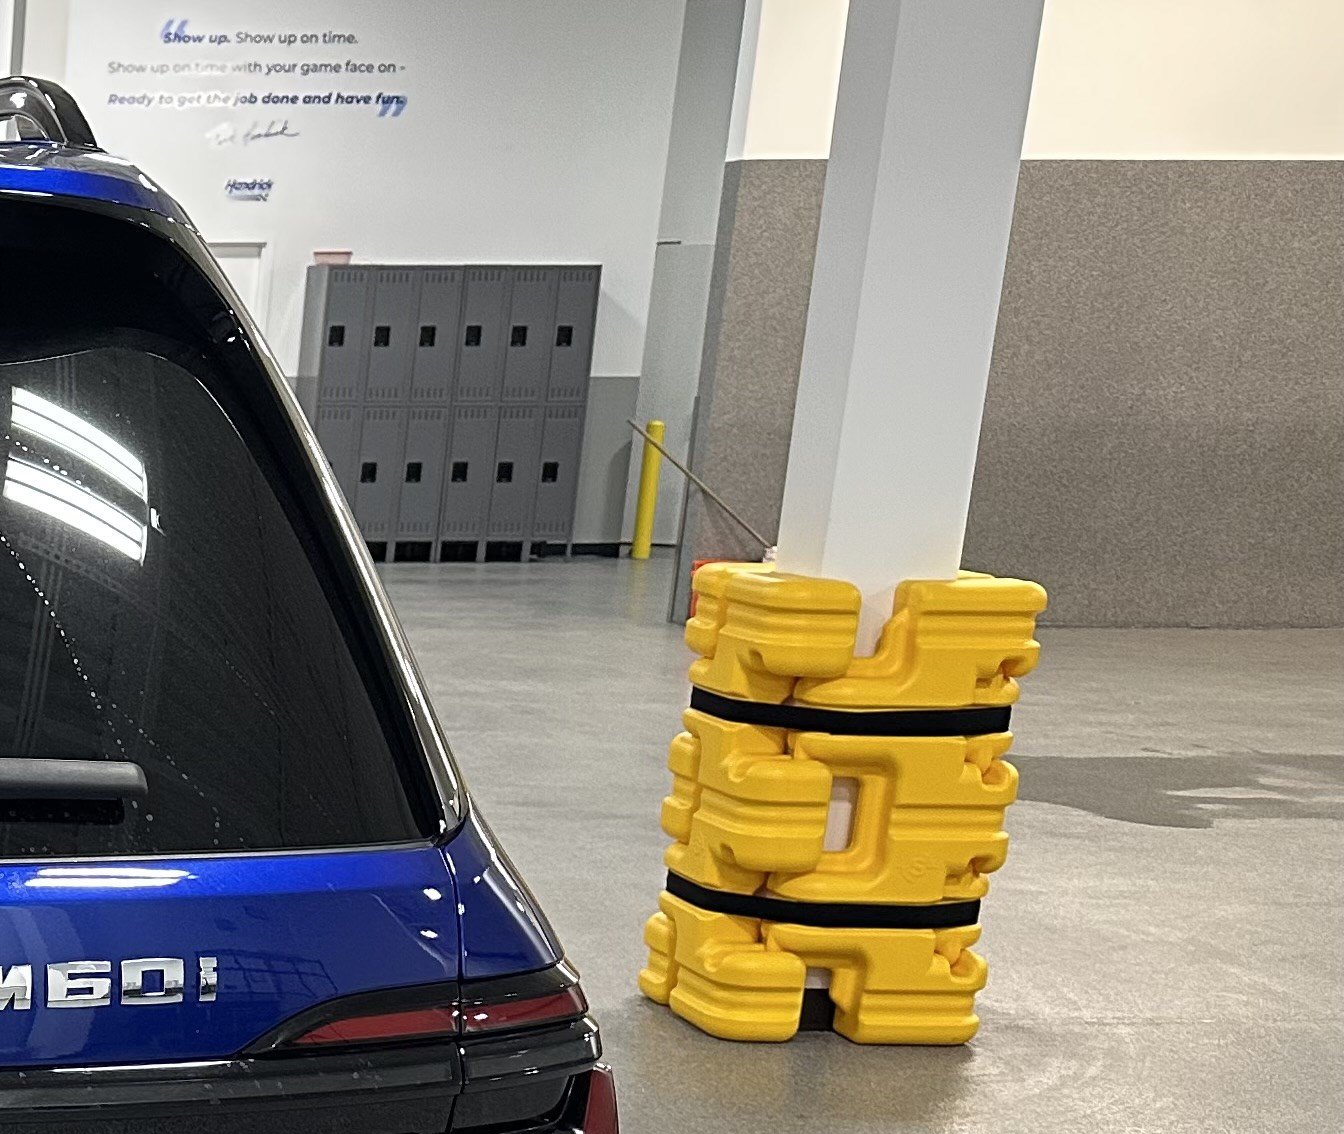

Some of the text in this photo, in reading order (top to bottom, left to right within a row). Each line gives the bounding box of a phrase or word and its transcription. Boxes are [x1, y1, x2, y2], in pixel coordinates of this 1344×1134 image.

[235, 31, 275, 44] Show
[278, 33, 297, 46] up
[301, 33, 319, 44] on
[322, 30, 359, 45] time.
[107, 61, 147, 74] Show
[151, 64, 170, 76] up
[172, 64, 192, 74] on
[231, 61, 262, 74] with
[265, 63, 298, 76] your
[300, 63, 342, 76] game
[345, 59, 375, 74] face
[377, 63, 397, 74] on
[107, 93, 155, 107] Ready
[158, 94, 174, 105] to
[177, 94, 202, 108] get
[206, 93, 231, 105] the
[232, 92, 259, 107] job
[261, 92, 300, 105] done
[302, 92, 333, 105] and
[334, 92, 372, 105] have
